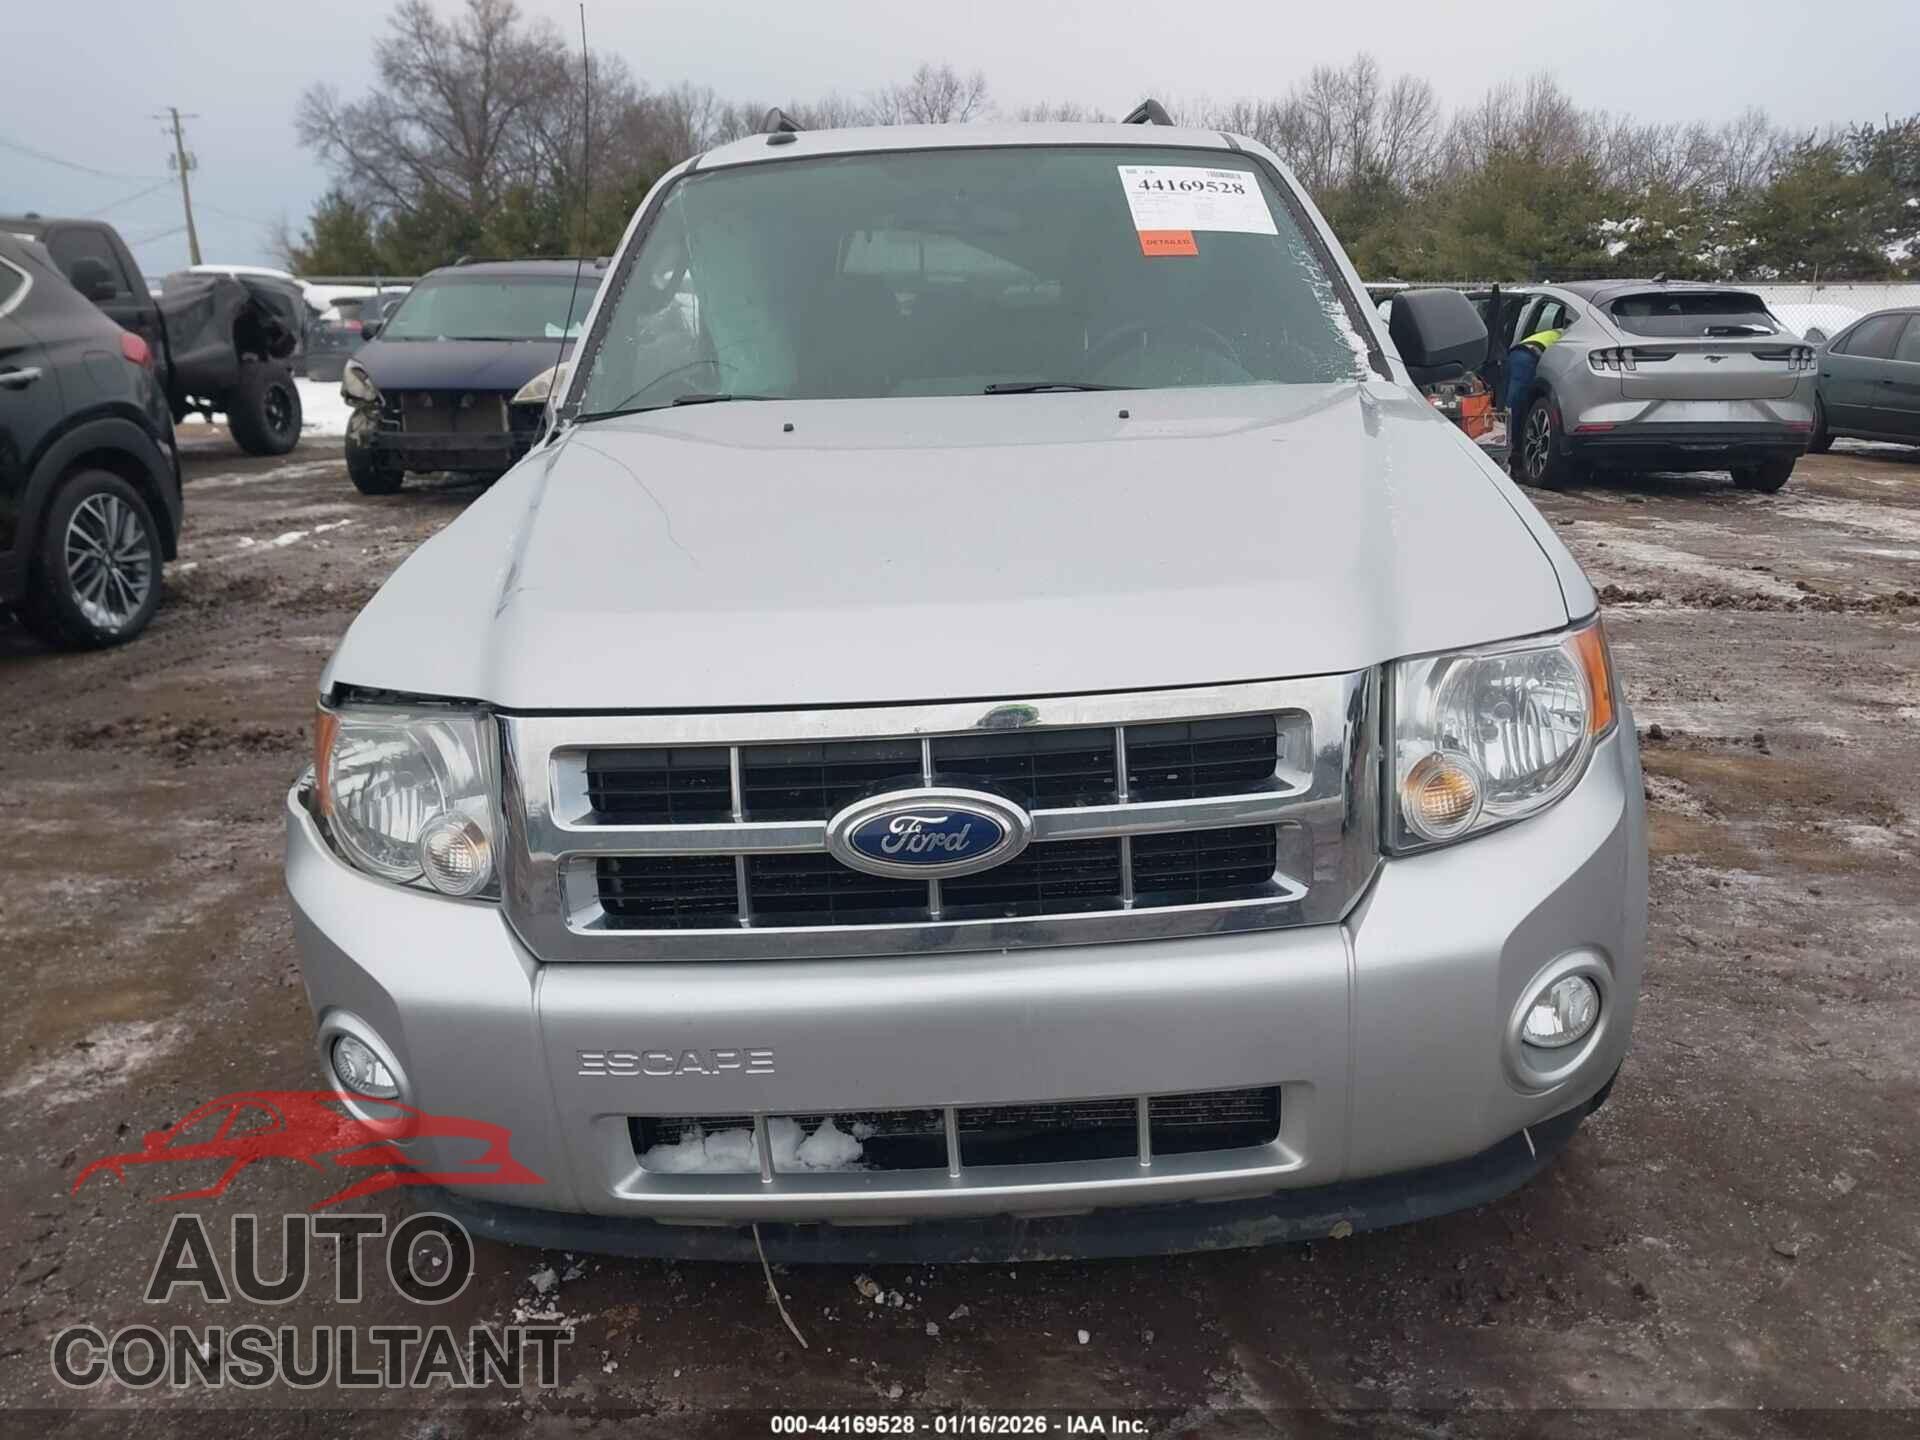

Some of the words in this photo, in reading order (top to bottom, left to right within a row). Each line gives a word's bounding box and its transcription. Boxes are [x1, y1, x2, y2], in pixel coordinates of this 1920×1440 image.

[1138, 178, 1246, 195] 44169528
[881, 815, 972, 854] Ford
[576, 1049, 776, 1077] ESCAPE
